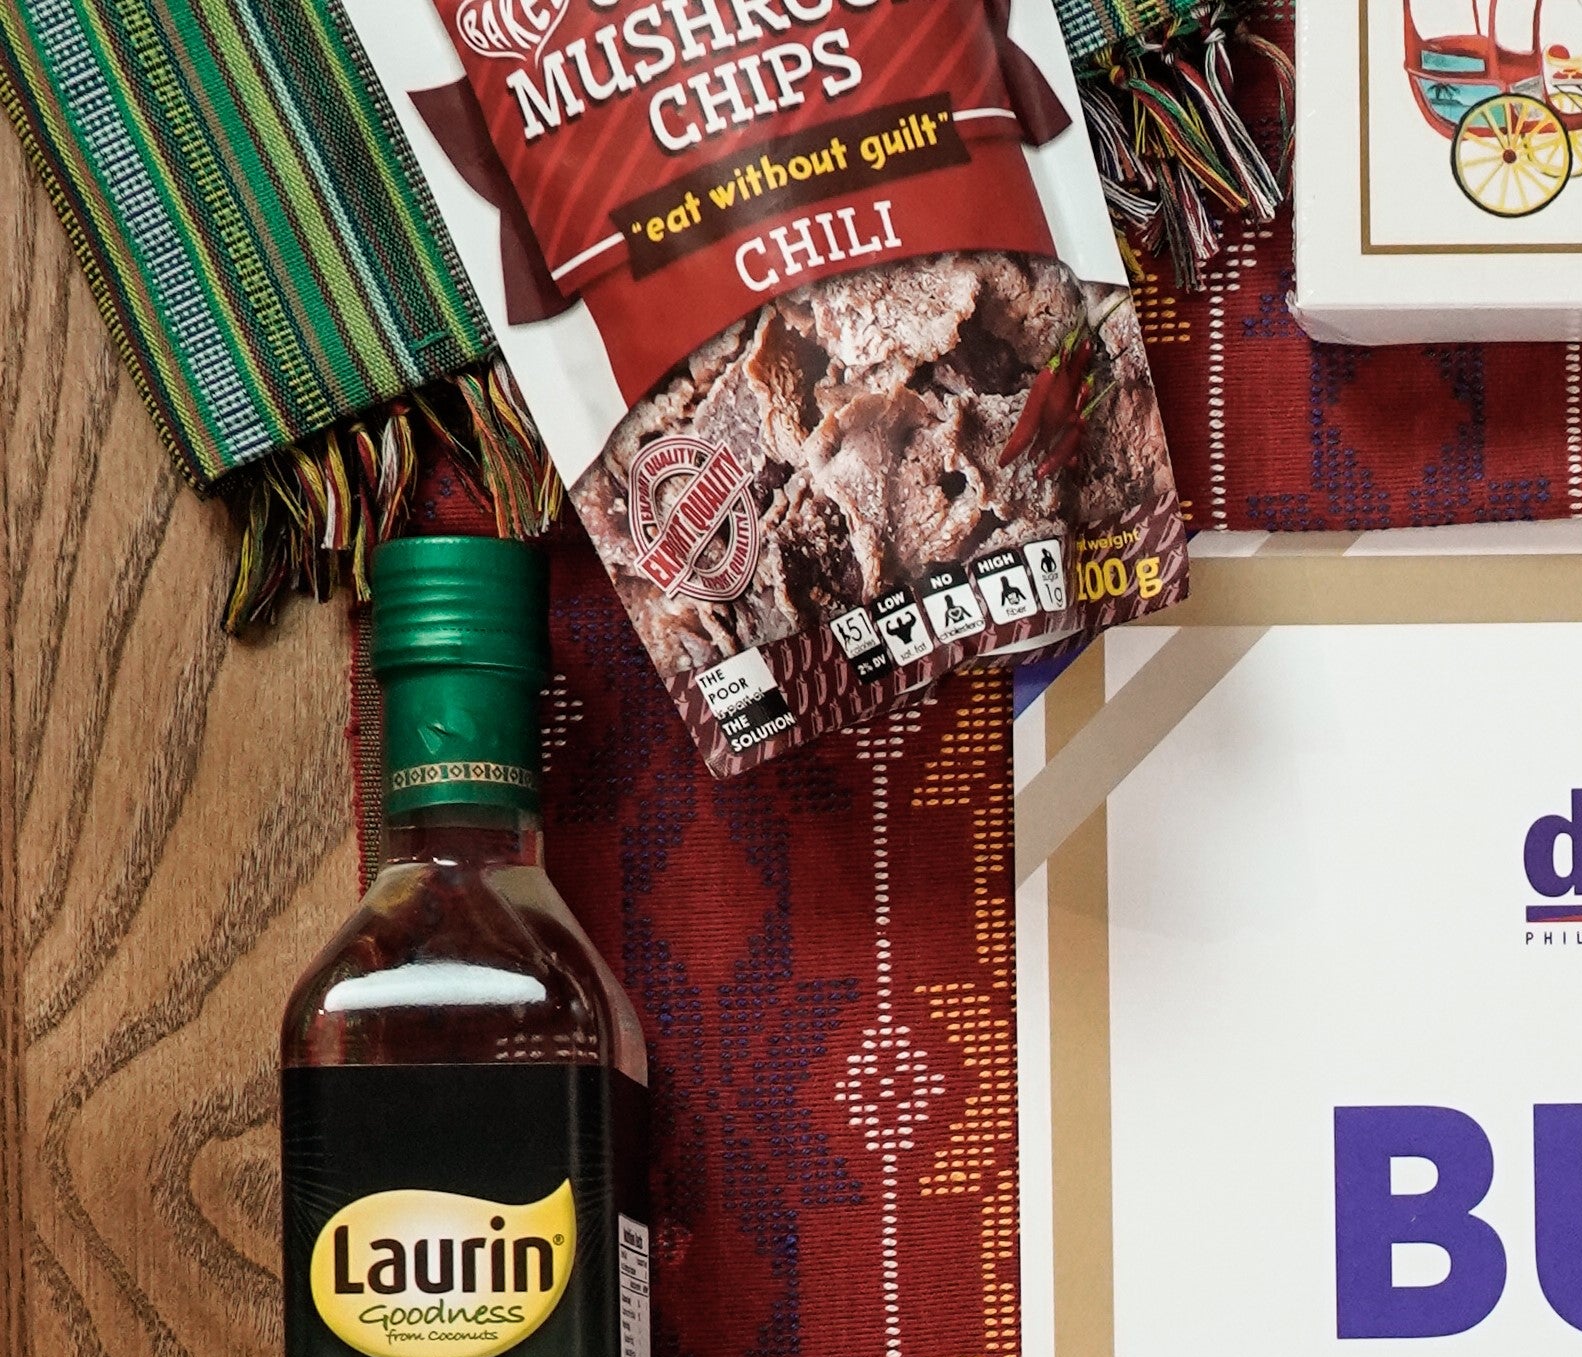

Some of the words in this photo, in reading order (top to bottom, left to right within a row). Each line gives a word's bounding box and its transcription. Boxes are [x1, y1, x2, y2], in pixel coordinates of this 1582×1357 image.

[463, 0, 563, 49] BAKE
[506, 0, 880, 140] MUSHR
[649, 28, 863, 151] CHIPS
[709, 137, 848, 210] without
[735, 200, 902, 292] CHILI
[643, 447, 694, 477] QUALITY
[641, 513, 698, 589] EXPORT
[680, 446, 744, 534] QUALITY
[1087, 527, 1142, 550] weight
[977, 552, 1015, 574] HIGH
[930, 573, 953, 590] NO
[1075, 557, 1128, 603] 100
[1135, 556, 1163, 600] g
[876, 591, 905, 613] LOW
[845, 612, 872, 642] 51
[699, 668, 726, 689] THE
[857, 661, 874, 676] 2%
[872, 653, 887, 668] DV
[708, 677, 749, 705] POOR
[721, 714, 751, 736] THE
[730, 711, 797, 753] SOLUTION
[358, 1298, 526, 1330] Goodness
[385, 1328, 426, 1345] from
[428, 1329, 500, 1342] Coconuts
